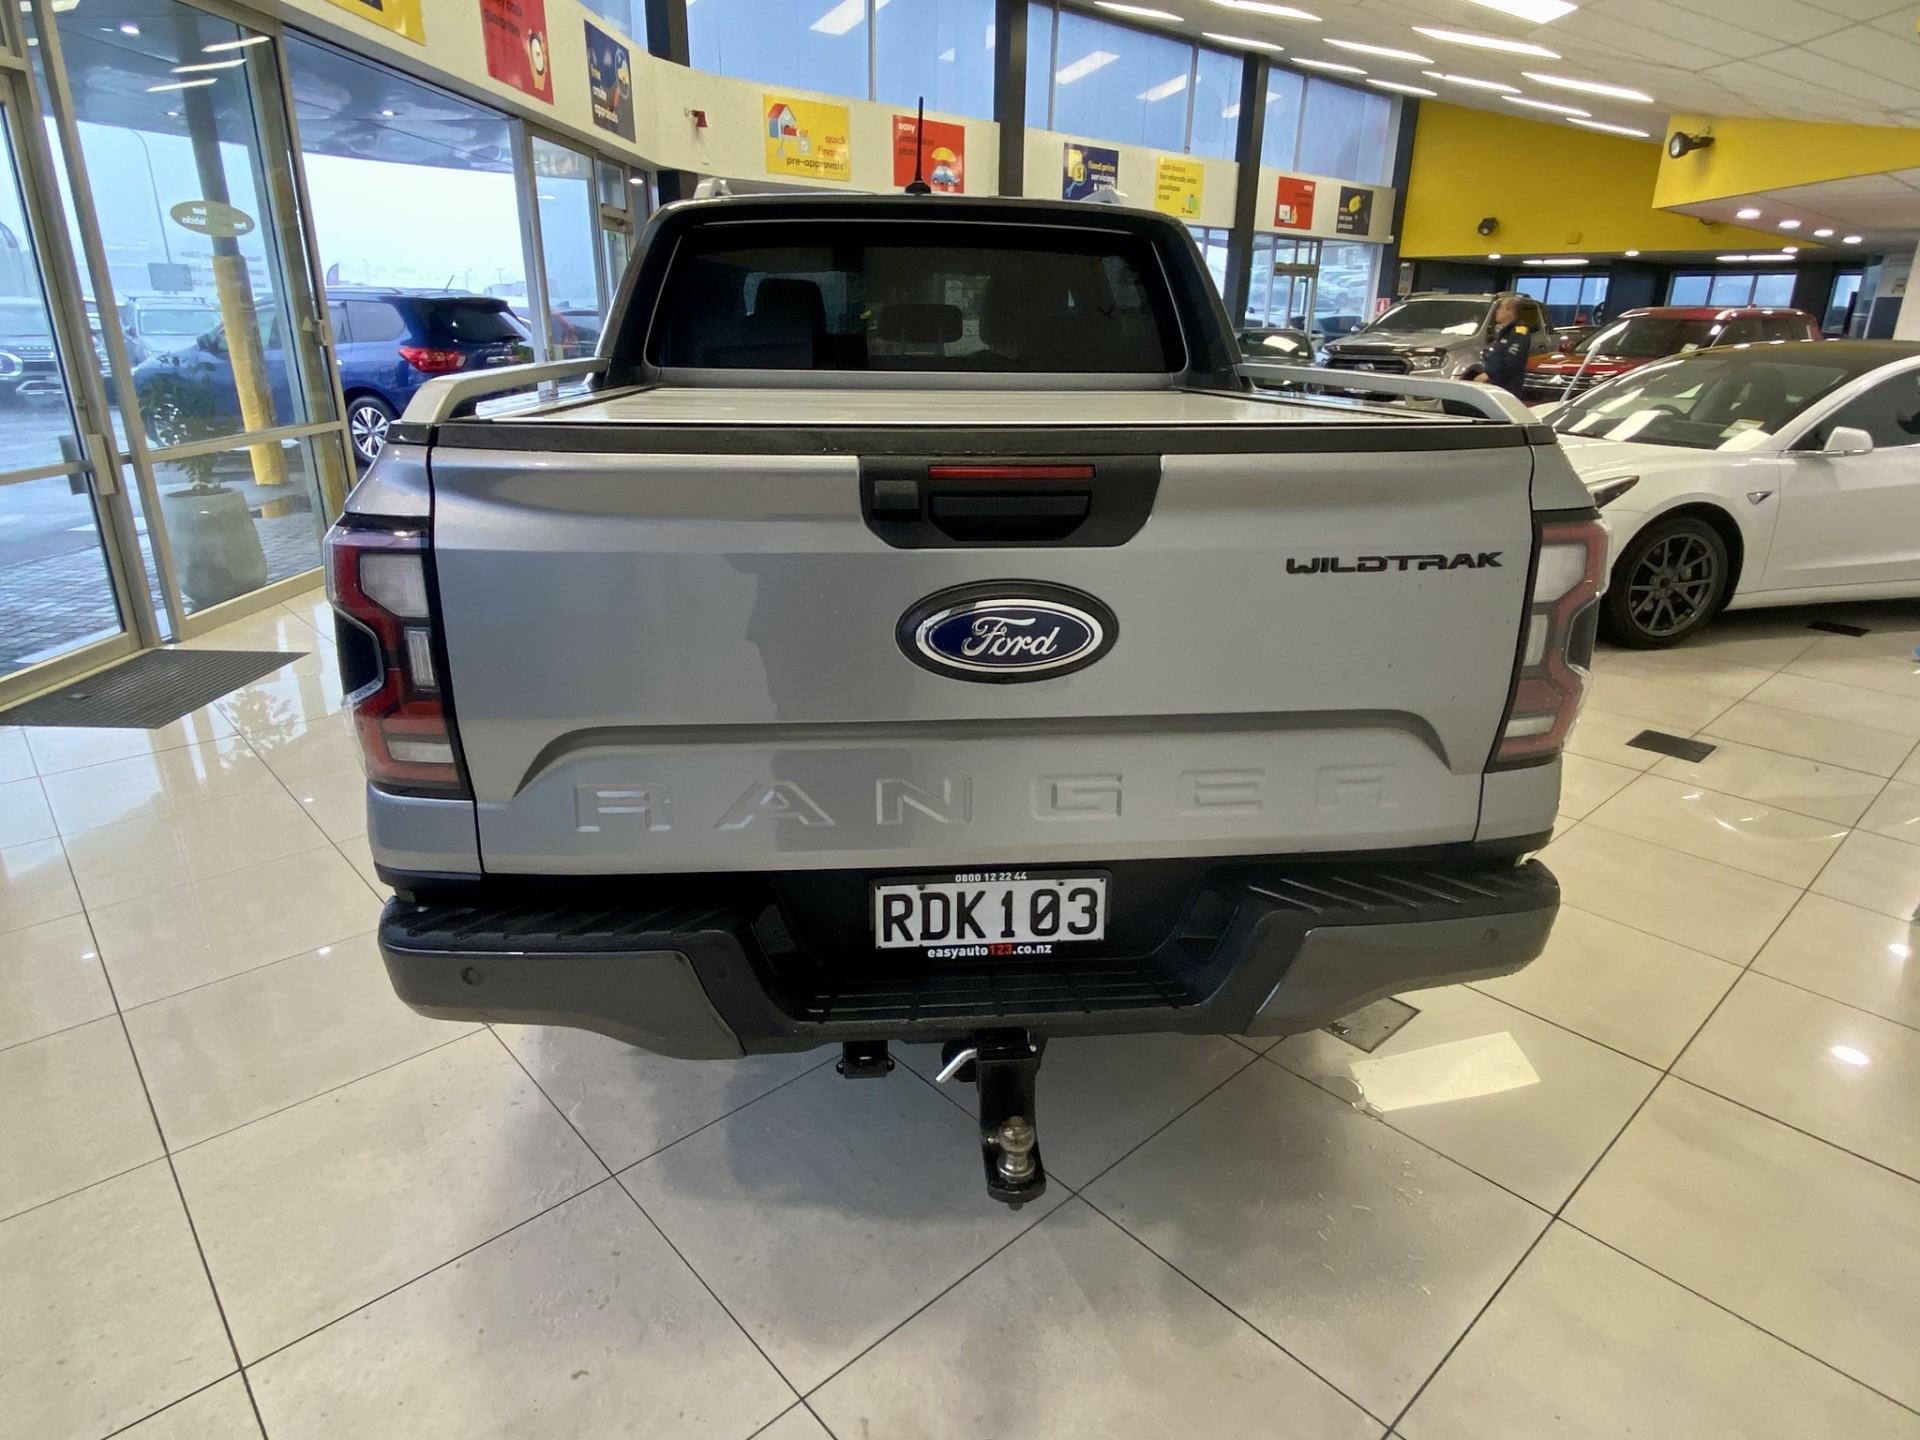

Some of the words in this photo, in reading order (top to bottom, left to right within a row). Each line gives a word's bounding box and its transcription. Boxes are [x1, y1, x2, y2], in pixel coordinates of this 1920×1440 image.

[898, 122, 916, 134] easy
[825, 135, 847, 145] quick
[898, 135, 935, 146] proteion
[1091, 173, 1115, 184] servicing
[1286, 550, 1504, 575] WILDTRAK
[960, 615, 1061, 658] Ford
[572, 762, 1400, 835] RANGER
[955, 872, 981, 883] 0800
[983, 872, 996, 882] 12
[998, 872, 1012, 881] 22
[1013, 871, 1028, 881] 44
[882, 887, 1098, 942] RDK103
[927, 943, 1052, 959] easyauto123.co.nz
